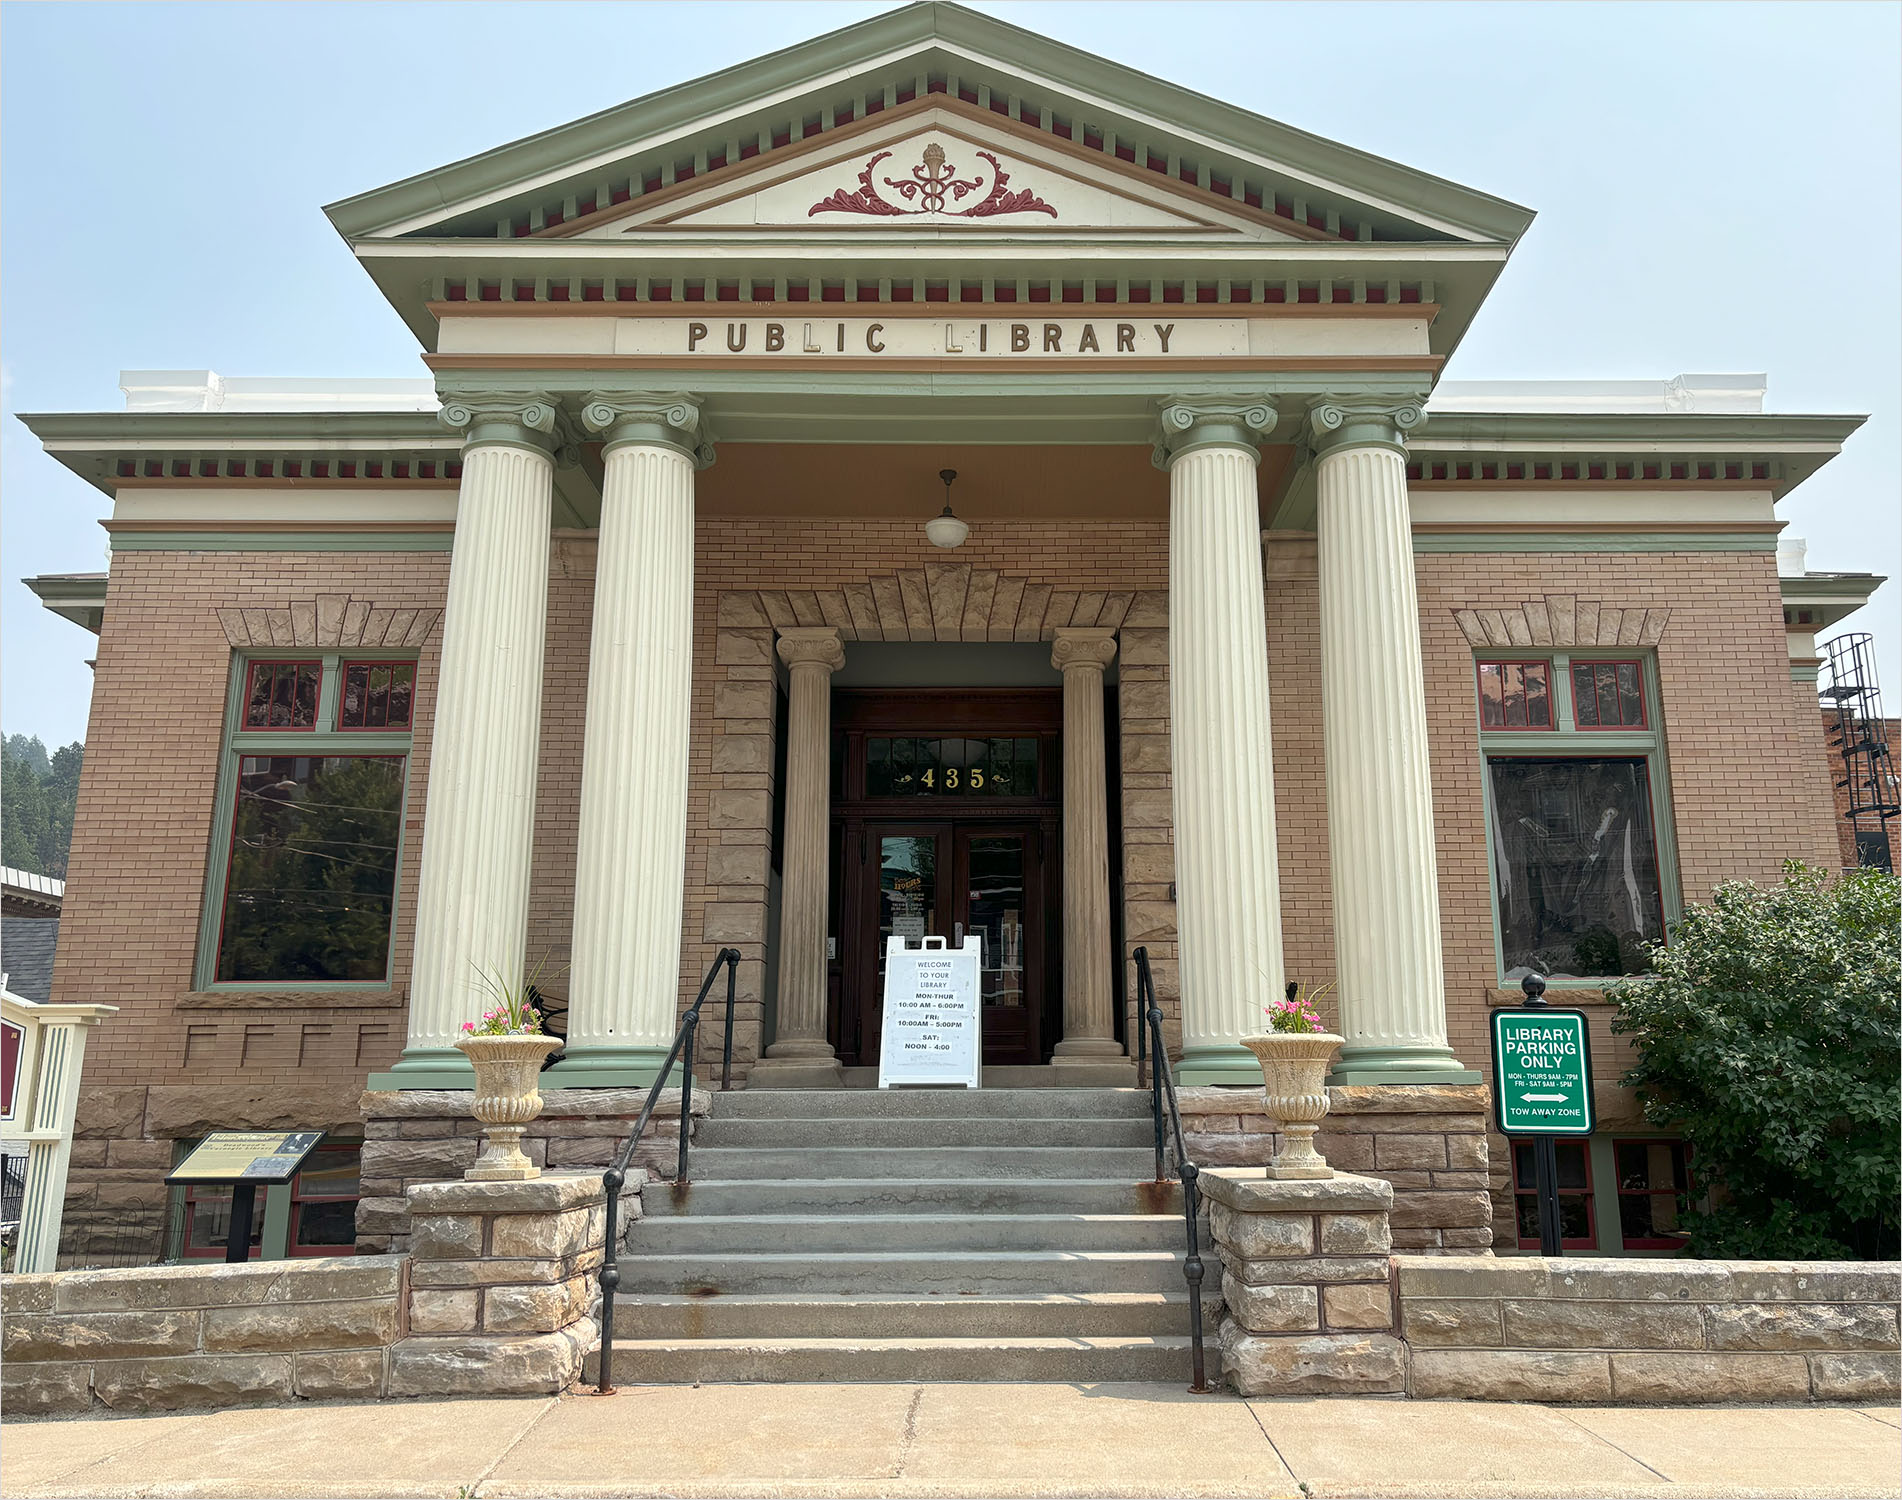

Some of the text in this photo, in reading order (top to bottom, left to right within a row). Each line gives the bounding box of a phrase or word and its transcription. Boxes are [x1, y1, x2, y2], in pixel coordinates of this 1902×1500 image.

[688, 322, 1176, 353] PUBLIC LIBRARY
[921, 768, 984, 789] 435
[1506, 1028, 1574, 1041] LIBRARY
[1506, 1042, 1577, 1055] PARKING
[1520, 1055, 1563, 1069] ONLY
[1510, 1107, 1581, 1116] TOW AWAY ZONE
